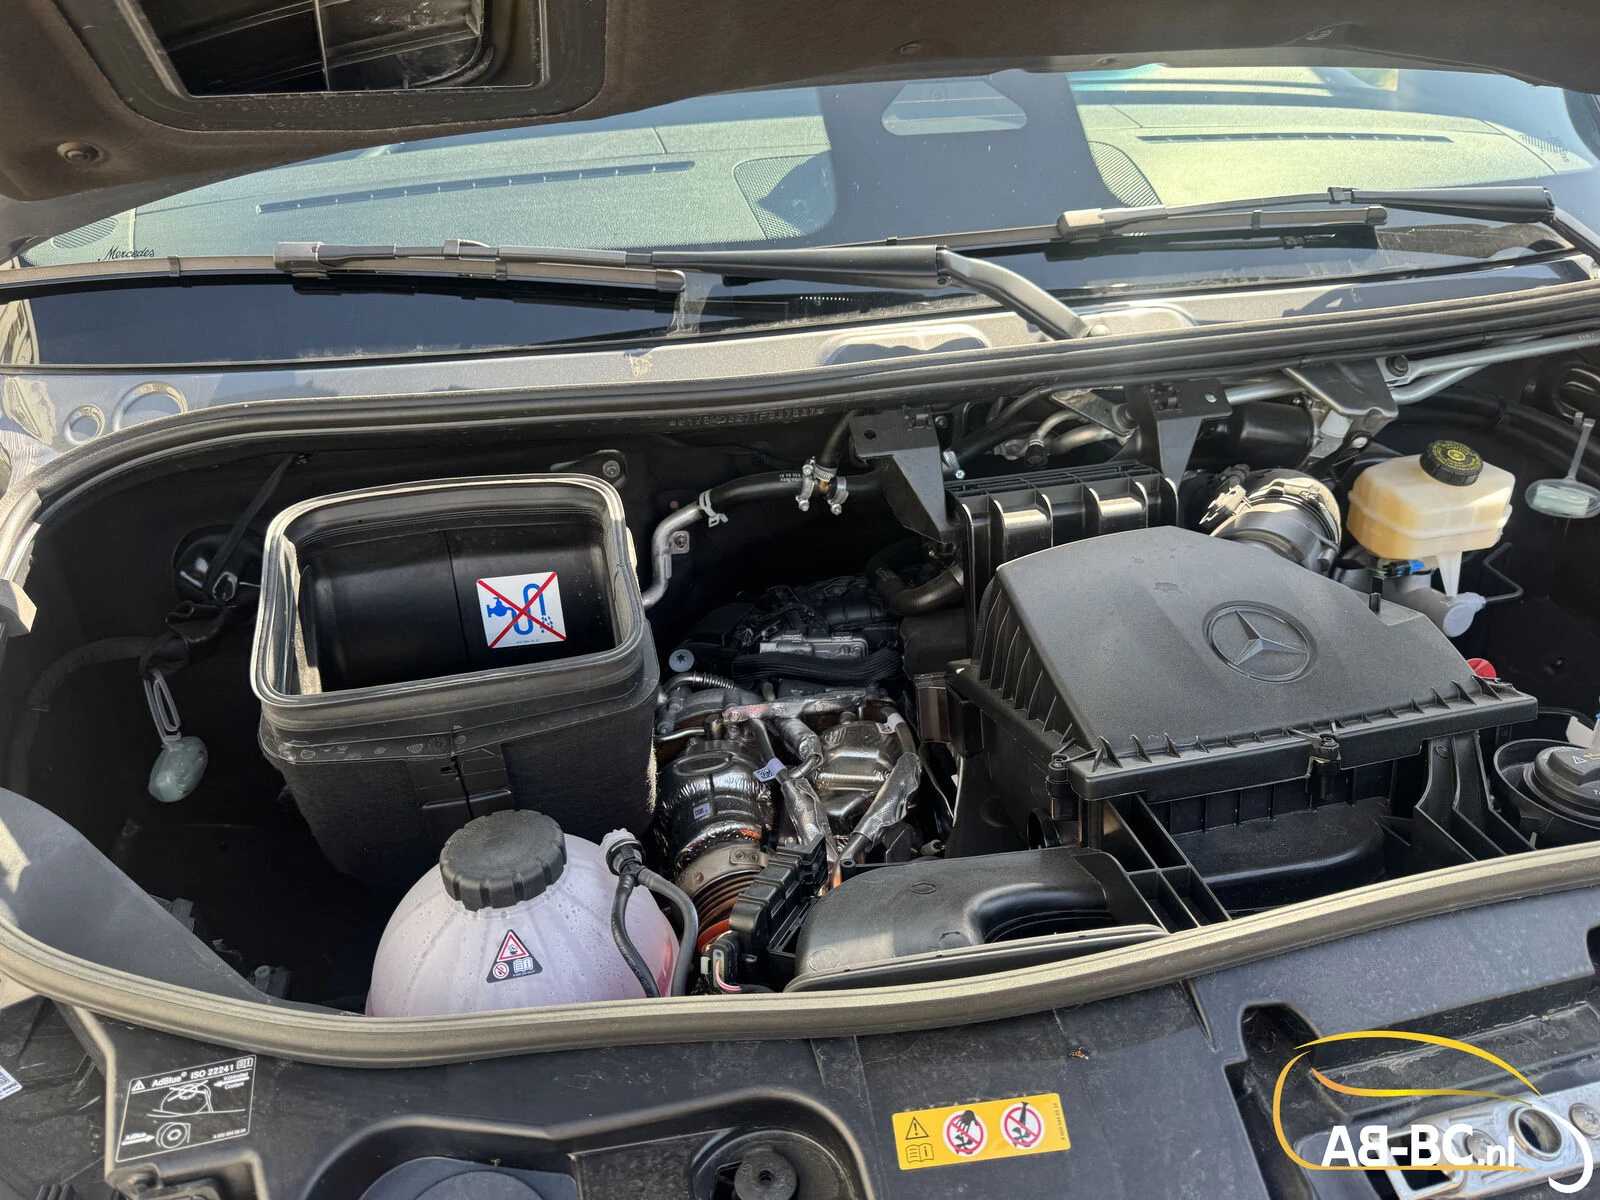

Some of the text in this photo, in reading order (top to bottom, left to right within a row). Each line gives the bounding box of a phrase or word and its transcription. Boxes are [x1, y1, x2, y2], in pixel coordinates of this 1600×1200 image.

[103, 245, 155, 261] Mercedes
[190, 1069, 206, 1080] ISO
[207, 1064, 234, 1076] 22241
